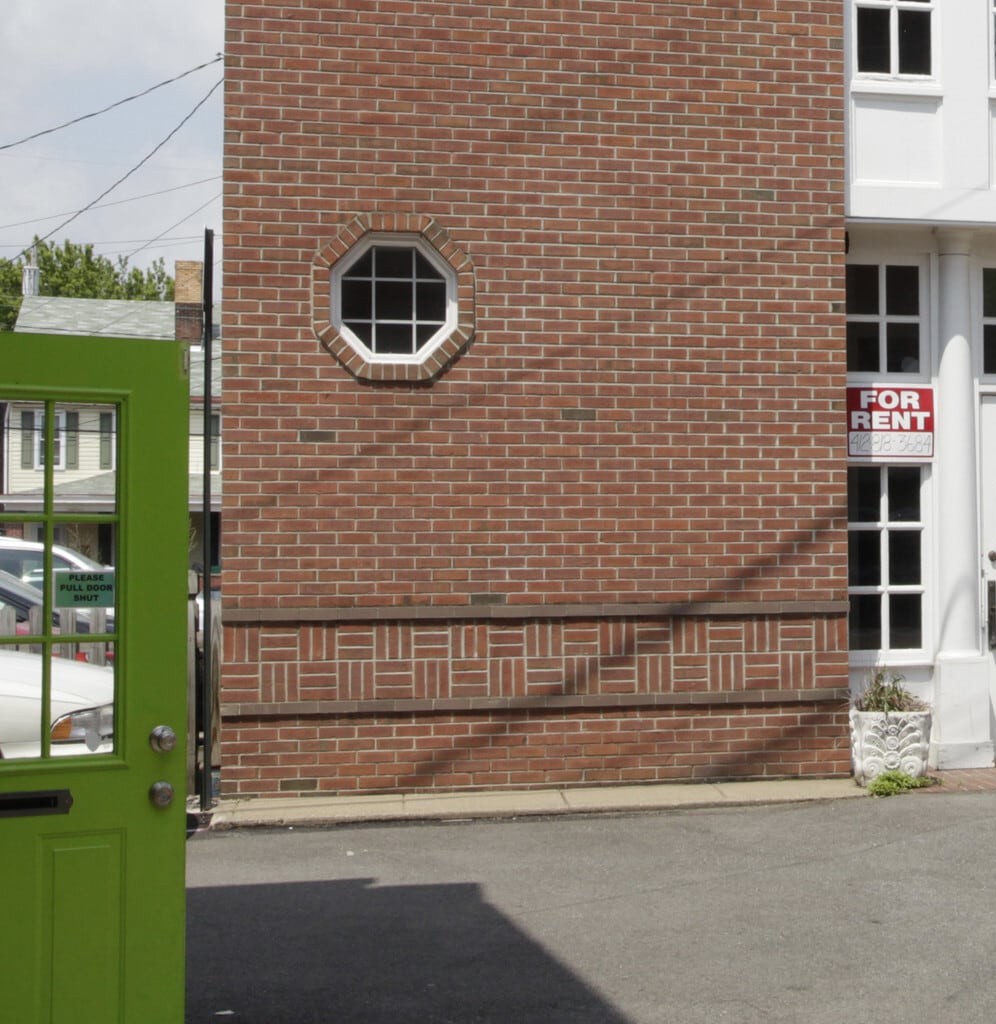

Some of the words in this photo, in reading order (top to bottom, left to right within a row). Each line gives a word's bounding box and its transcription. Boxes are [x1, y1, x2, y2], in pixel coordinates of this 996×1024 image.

[860, 390, 920, 409] FOR
[851, 411, 931, 430] RENT
[68, 574, 105, 582] PLEASE
[60, 584, 83, 592] PULL
[86, 584, 113, 592] DOOR
[73, 594, 99, 602] SHUT
